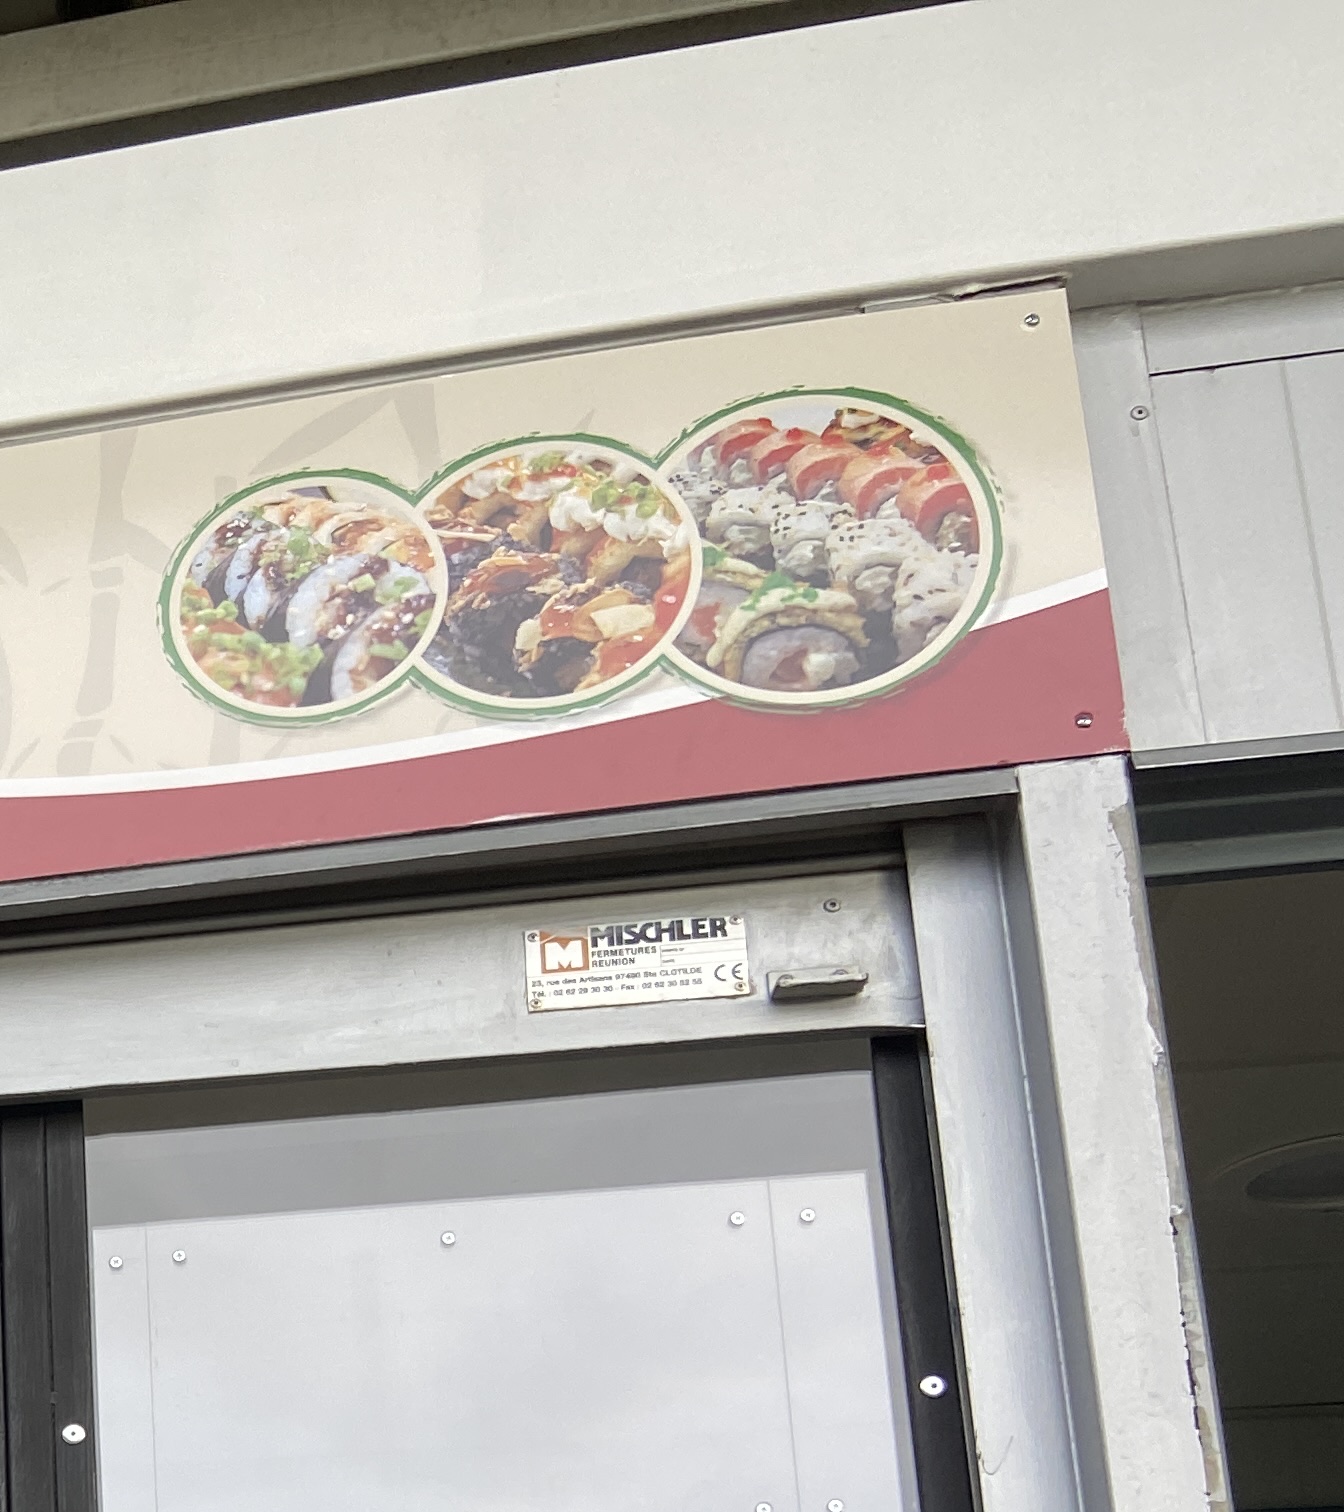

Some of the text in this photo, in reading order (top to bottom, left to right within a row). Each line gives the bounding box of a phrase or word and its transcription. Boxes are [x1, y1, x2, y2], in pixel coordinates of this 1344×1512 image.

[591, 917, 728, 948] MISCHLER
[591, 946, 657, 959] FERMETURES
[591, 957, 636, 968] REUNION
[659, 967, 703, 977] CLOTILDE
